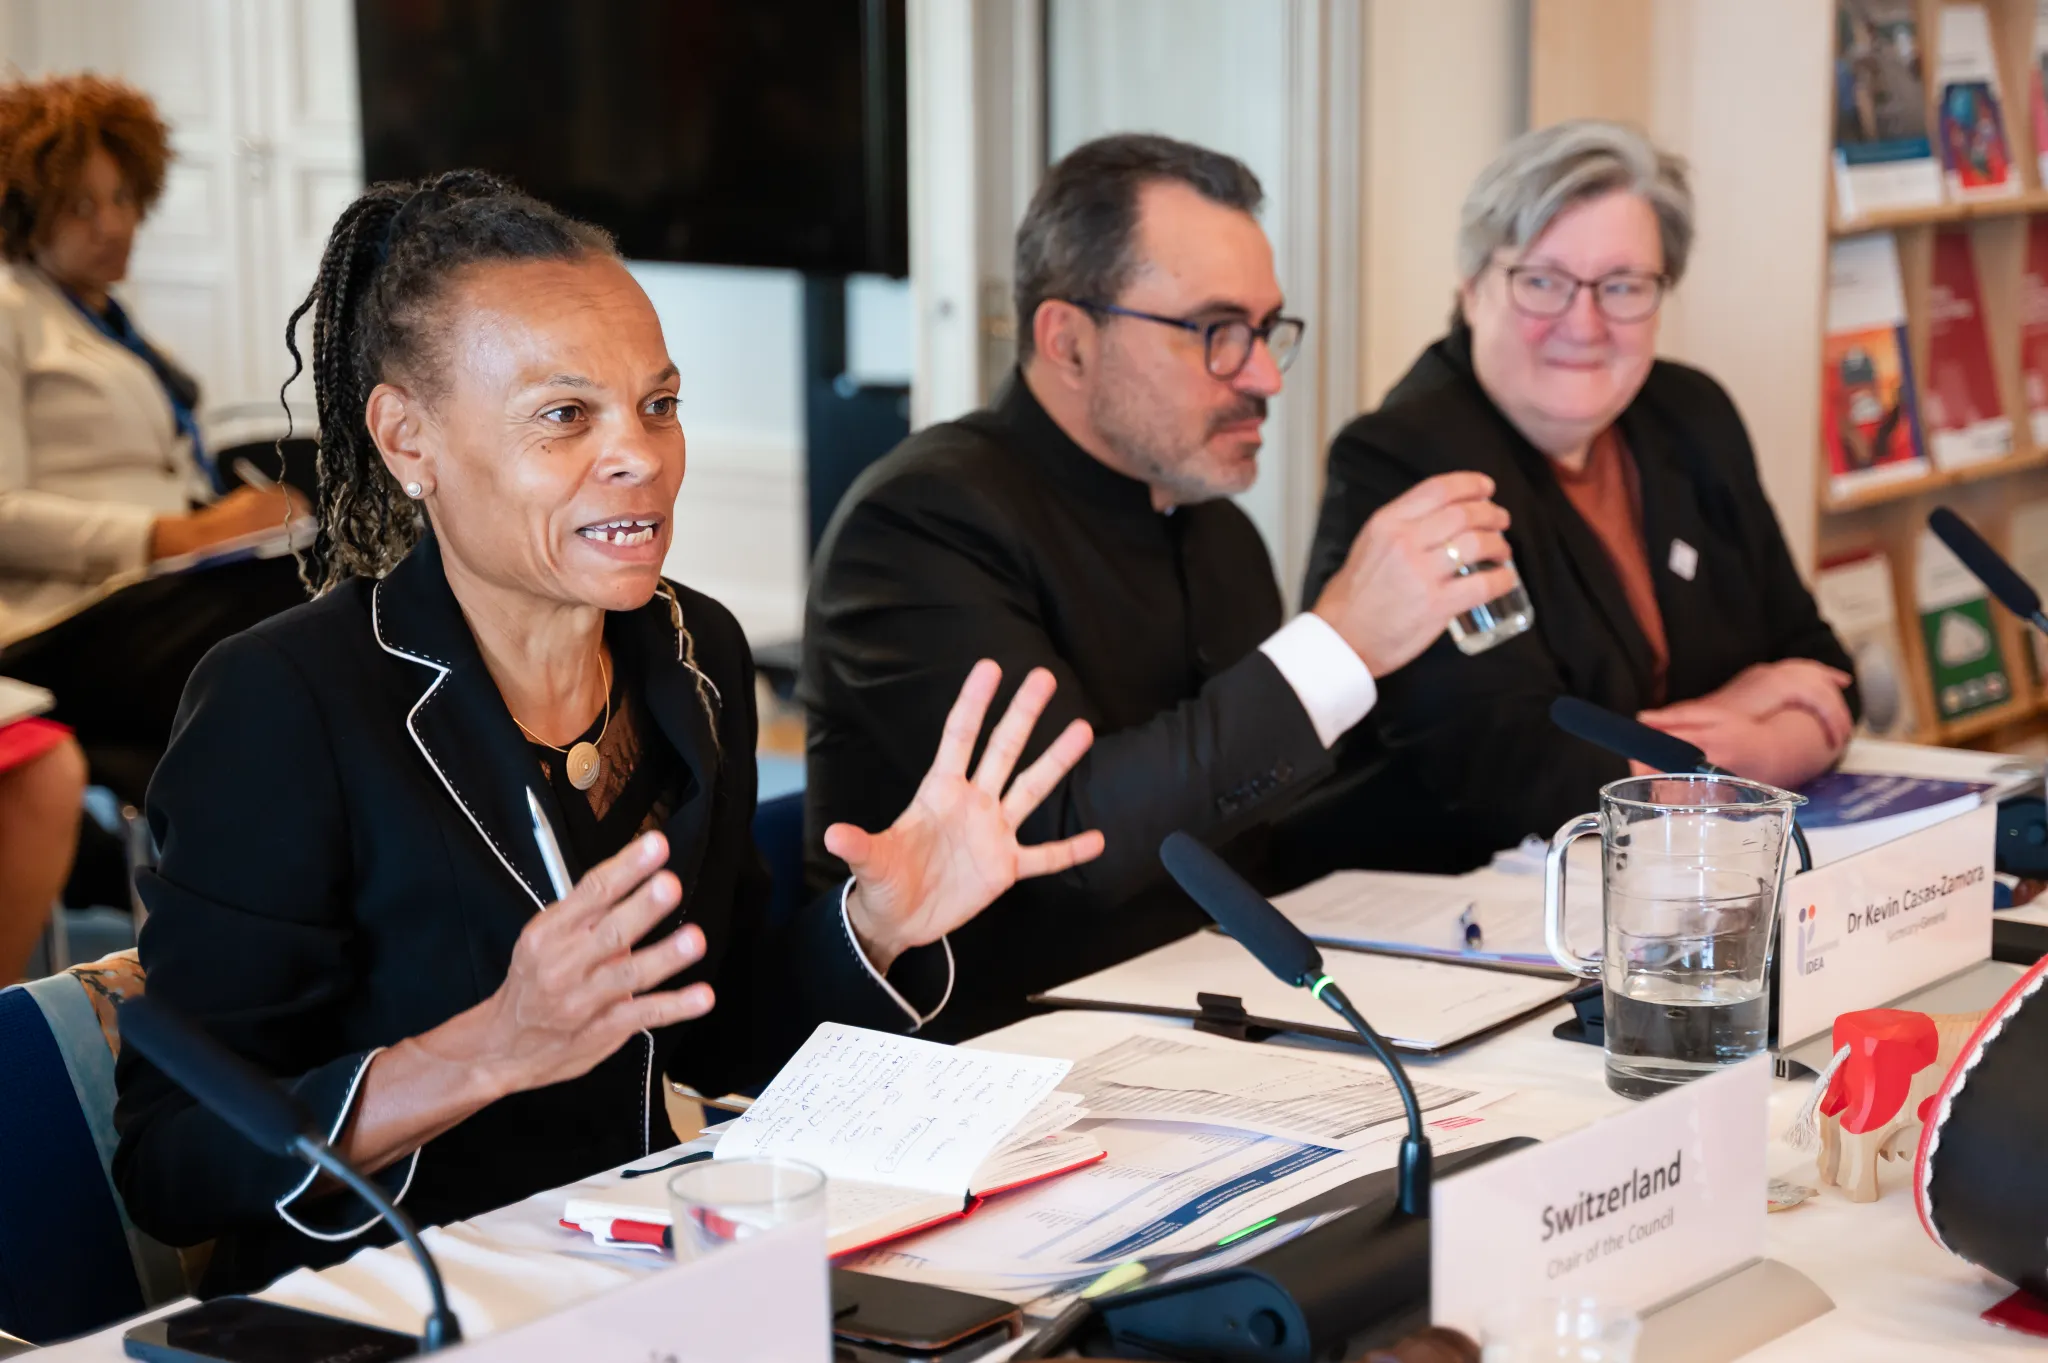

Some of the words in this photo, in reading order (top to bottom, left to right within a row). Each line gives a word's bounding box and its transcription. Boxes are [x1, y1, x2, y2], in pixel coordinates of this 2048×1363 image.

[1848, 912, 1862, 934] Dr
[1866, 897, 1899, 927] Kevin
[1903, 866, 1984, 911] Casas-Zamora
[1806, 956, 1824, 975] IDEA
[1541, 1149, 1681, 1242] Switzerland
[1547, 1252, 1583, 1280] Chair
[1586, 1240, 1600, 1264] of
[1602, 1234, 1624, 1256] the
[1628, 1207, 1674, 1244] Council
